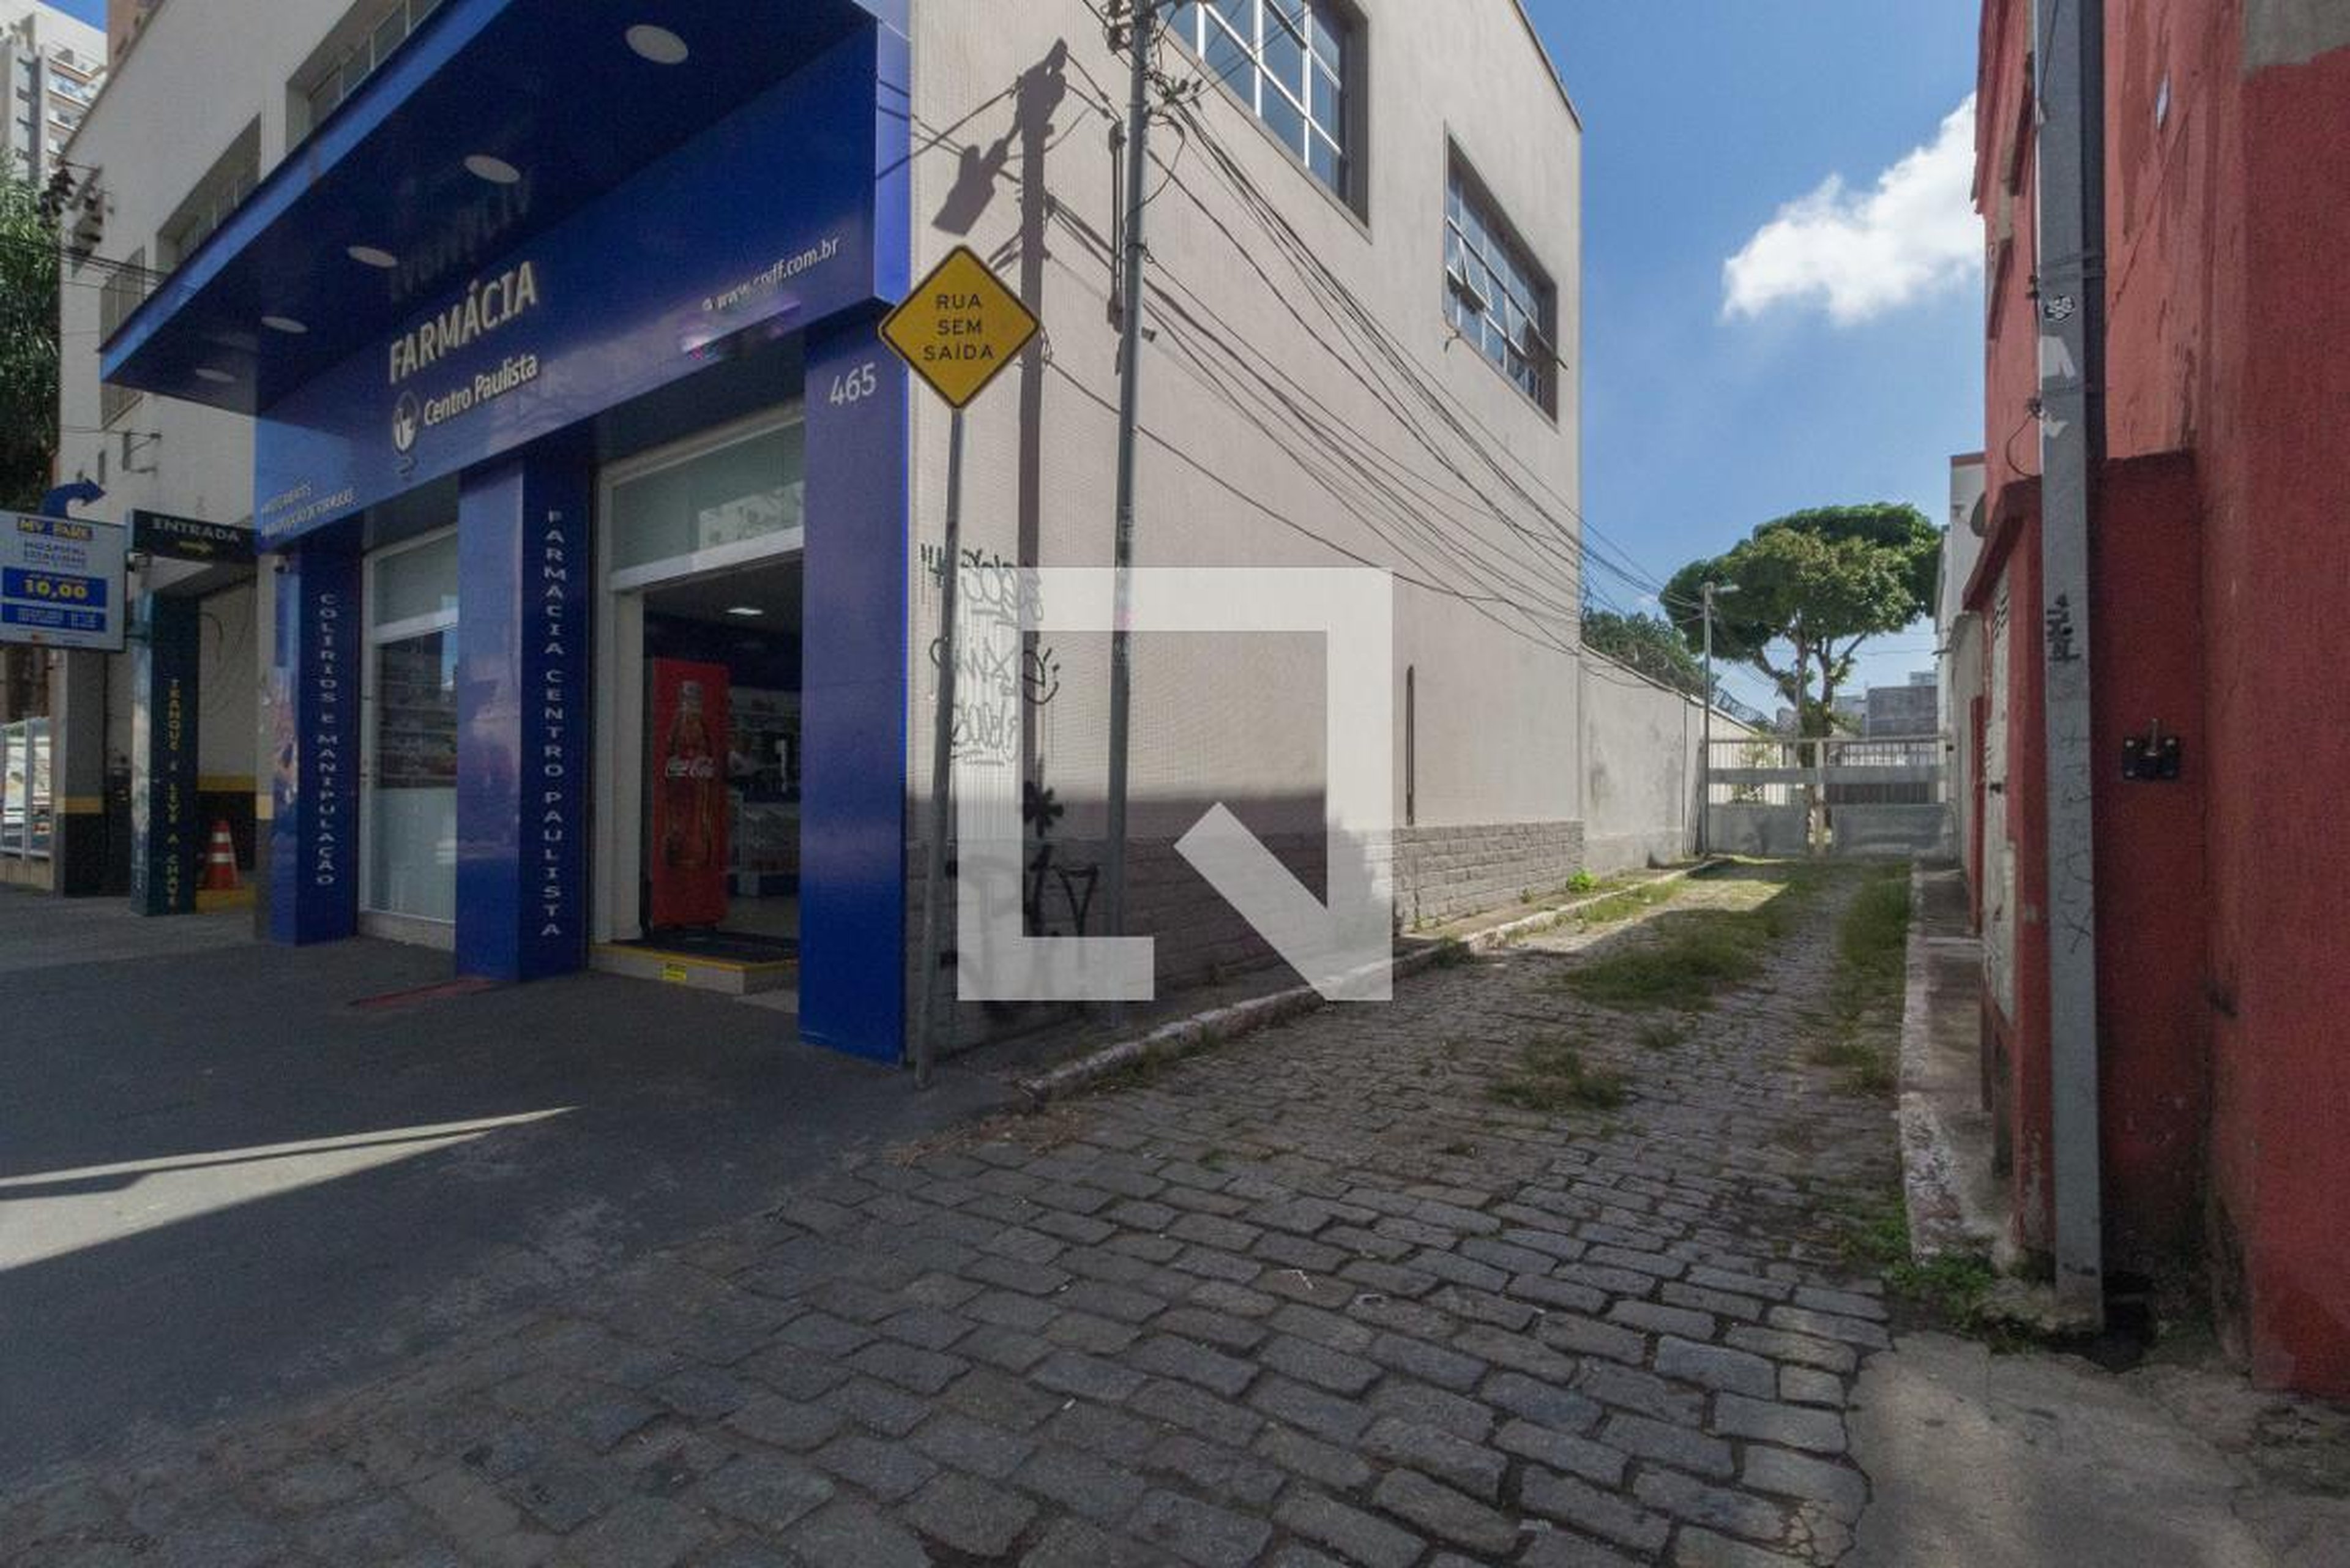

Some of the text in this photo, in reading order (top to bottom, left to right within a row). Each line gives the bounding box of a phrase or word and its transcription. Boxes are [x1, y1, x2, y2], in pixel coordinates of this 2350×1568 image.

[389, 260, 538, 384] FARMÁCIA
[936, 293, 983, 310] RUA
[937, 319, 982, 335] SEM
[923, 341, 994, 360] SAÍDA
[423, 353, 538, 425] Centro Paulista
[830, 362, 876, 406] 465
[151, 517, 241, 542] ENTRADA
[543, 669, 564, 777] CENTRO
[540, 791, 563, 936] PAULISTA
